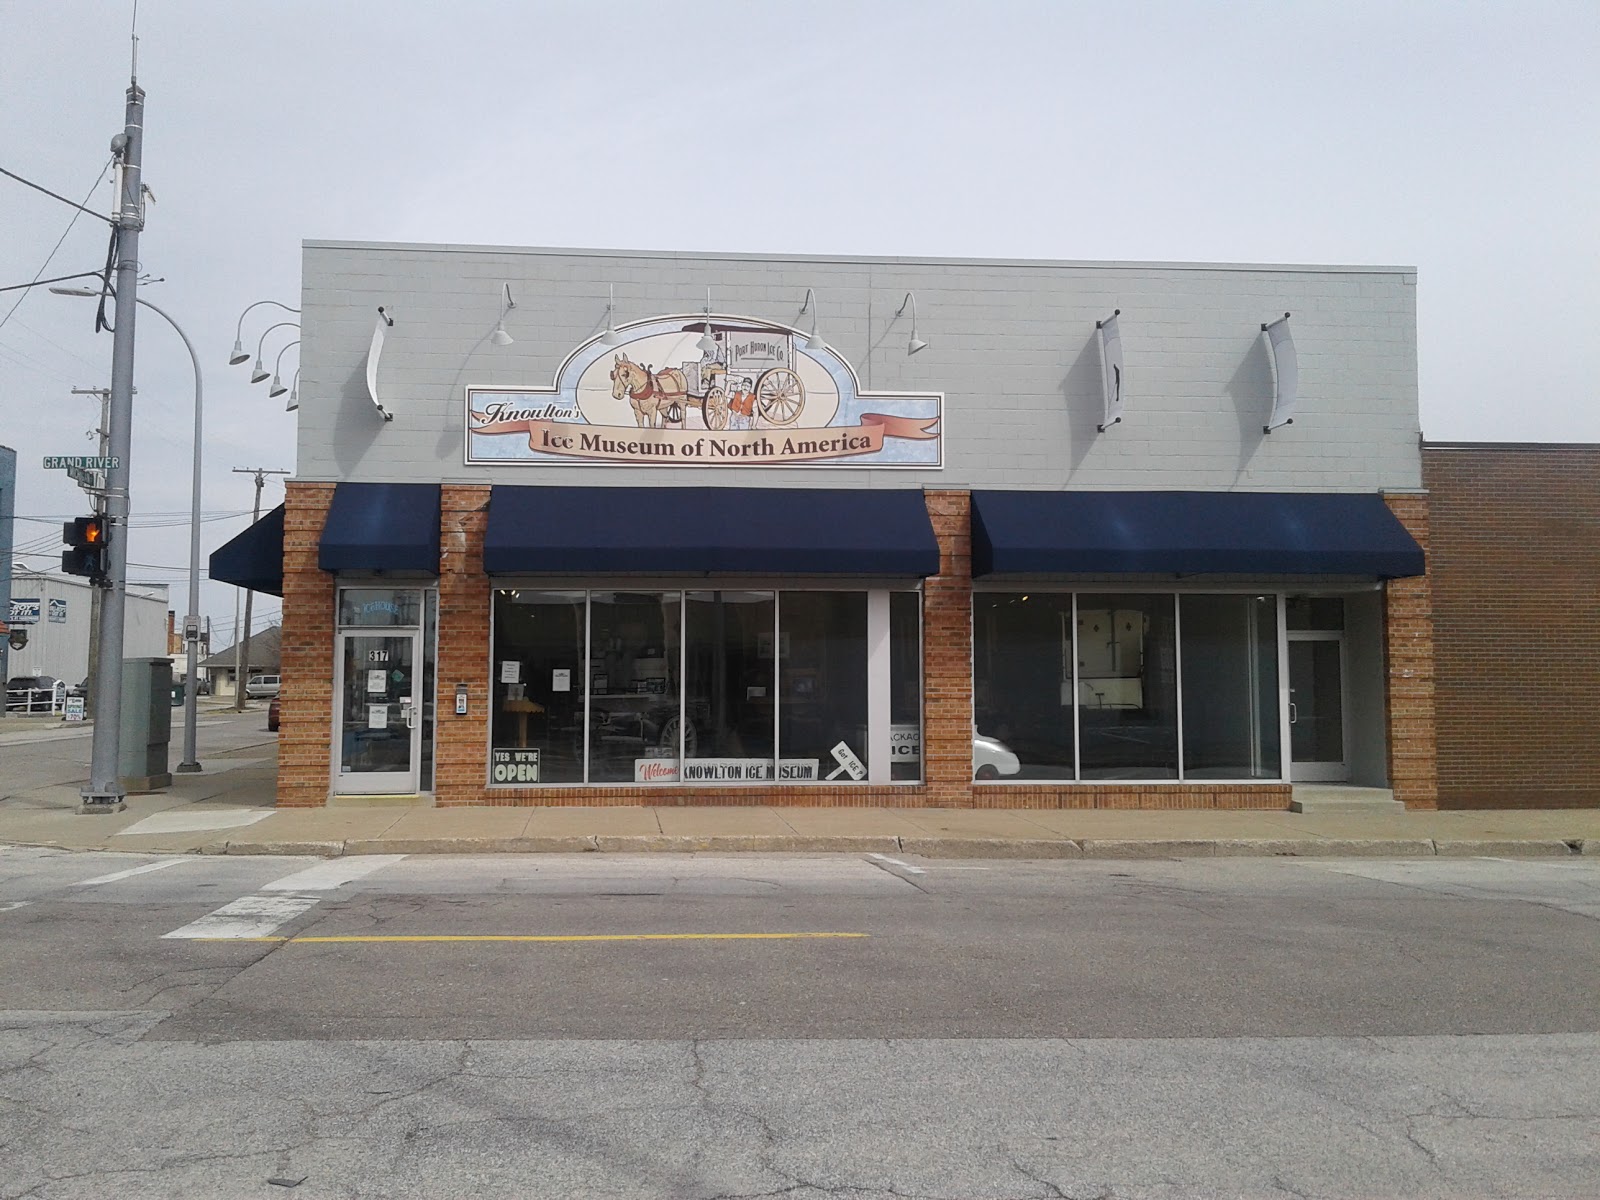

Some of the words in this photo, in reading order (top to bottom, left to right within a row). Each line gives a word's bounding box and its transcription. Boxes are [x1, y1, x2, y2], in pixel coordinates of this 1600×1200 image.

[541, 429, 574, 450] Ice
[580, 433, 675, 456] Museum
[681, 438, 705, 457] of
[708, 438, 775, 457] North
[780, 433, 872, 455] America
[44, 457, 82, 469] GRAND
[86, 457, 119, 469] RIVER
[369, 650, 388, 661] 317
[838, 748, 848, 760] Got
[891, 745, 920, 755] ICE
[495, 752, 510, 762] YES
[514, 752, 538, 762] WE'RE
[494, 763, 538, 782] OPEN
[639, 763, 679, 781] Welcome
[745, 764, 763, 779] ICE
